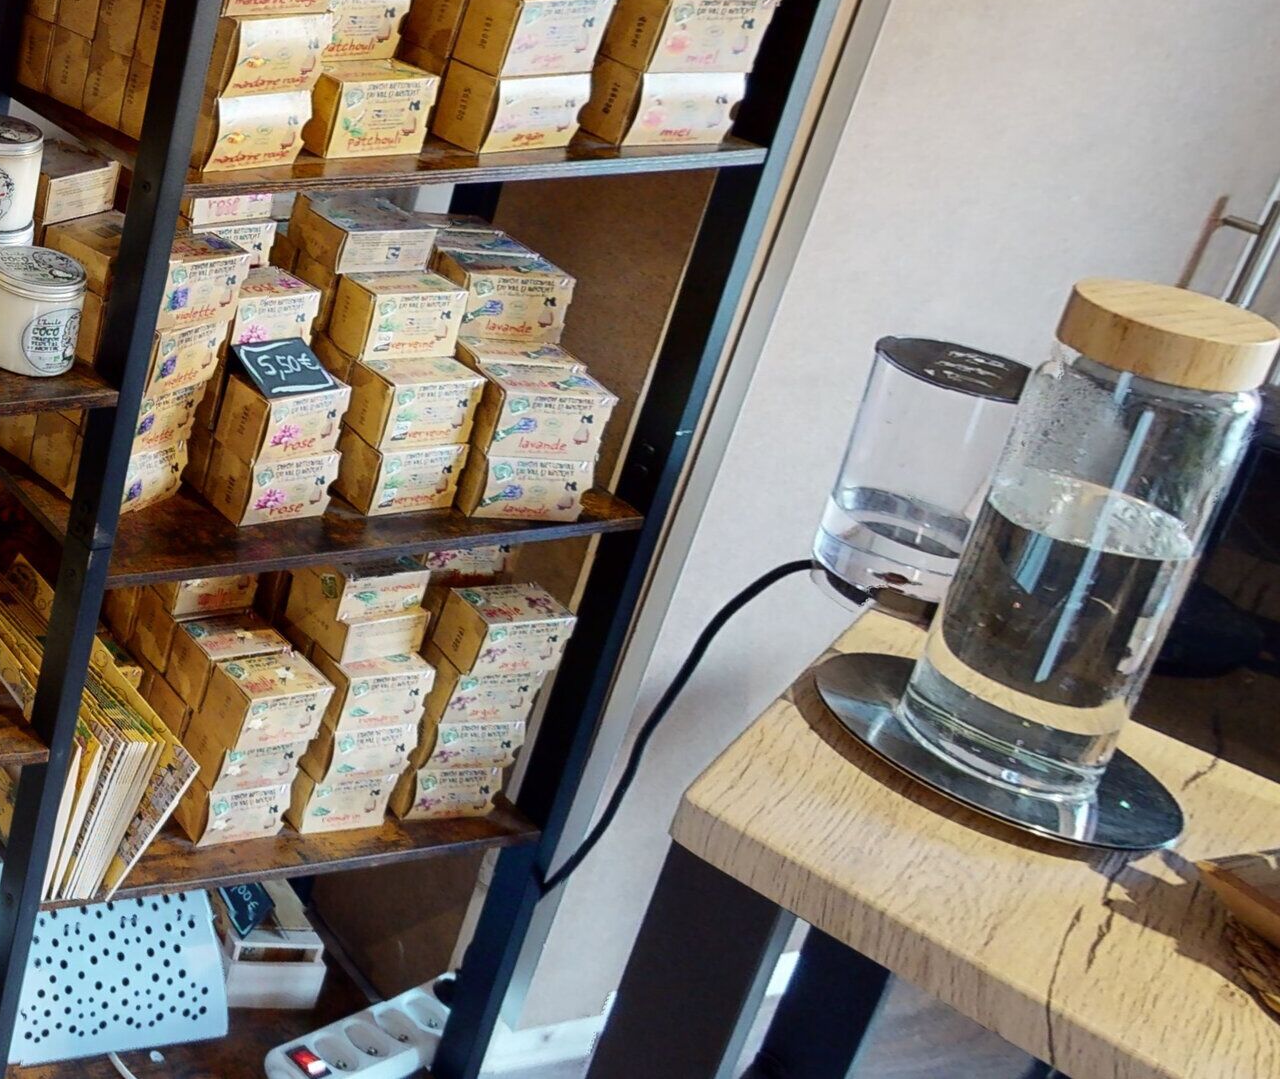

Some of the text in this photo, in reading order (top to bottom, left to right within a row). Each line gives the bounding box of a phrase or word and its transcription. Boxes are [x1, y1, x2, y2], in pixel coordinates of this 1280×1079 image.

[485, 321, 533, 335] lavande
[518, 437, 568, 452] lavande
[269, 500, 304, 516] rose
